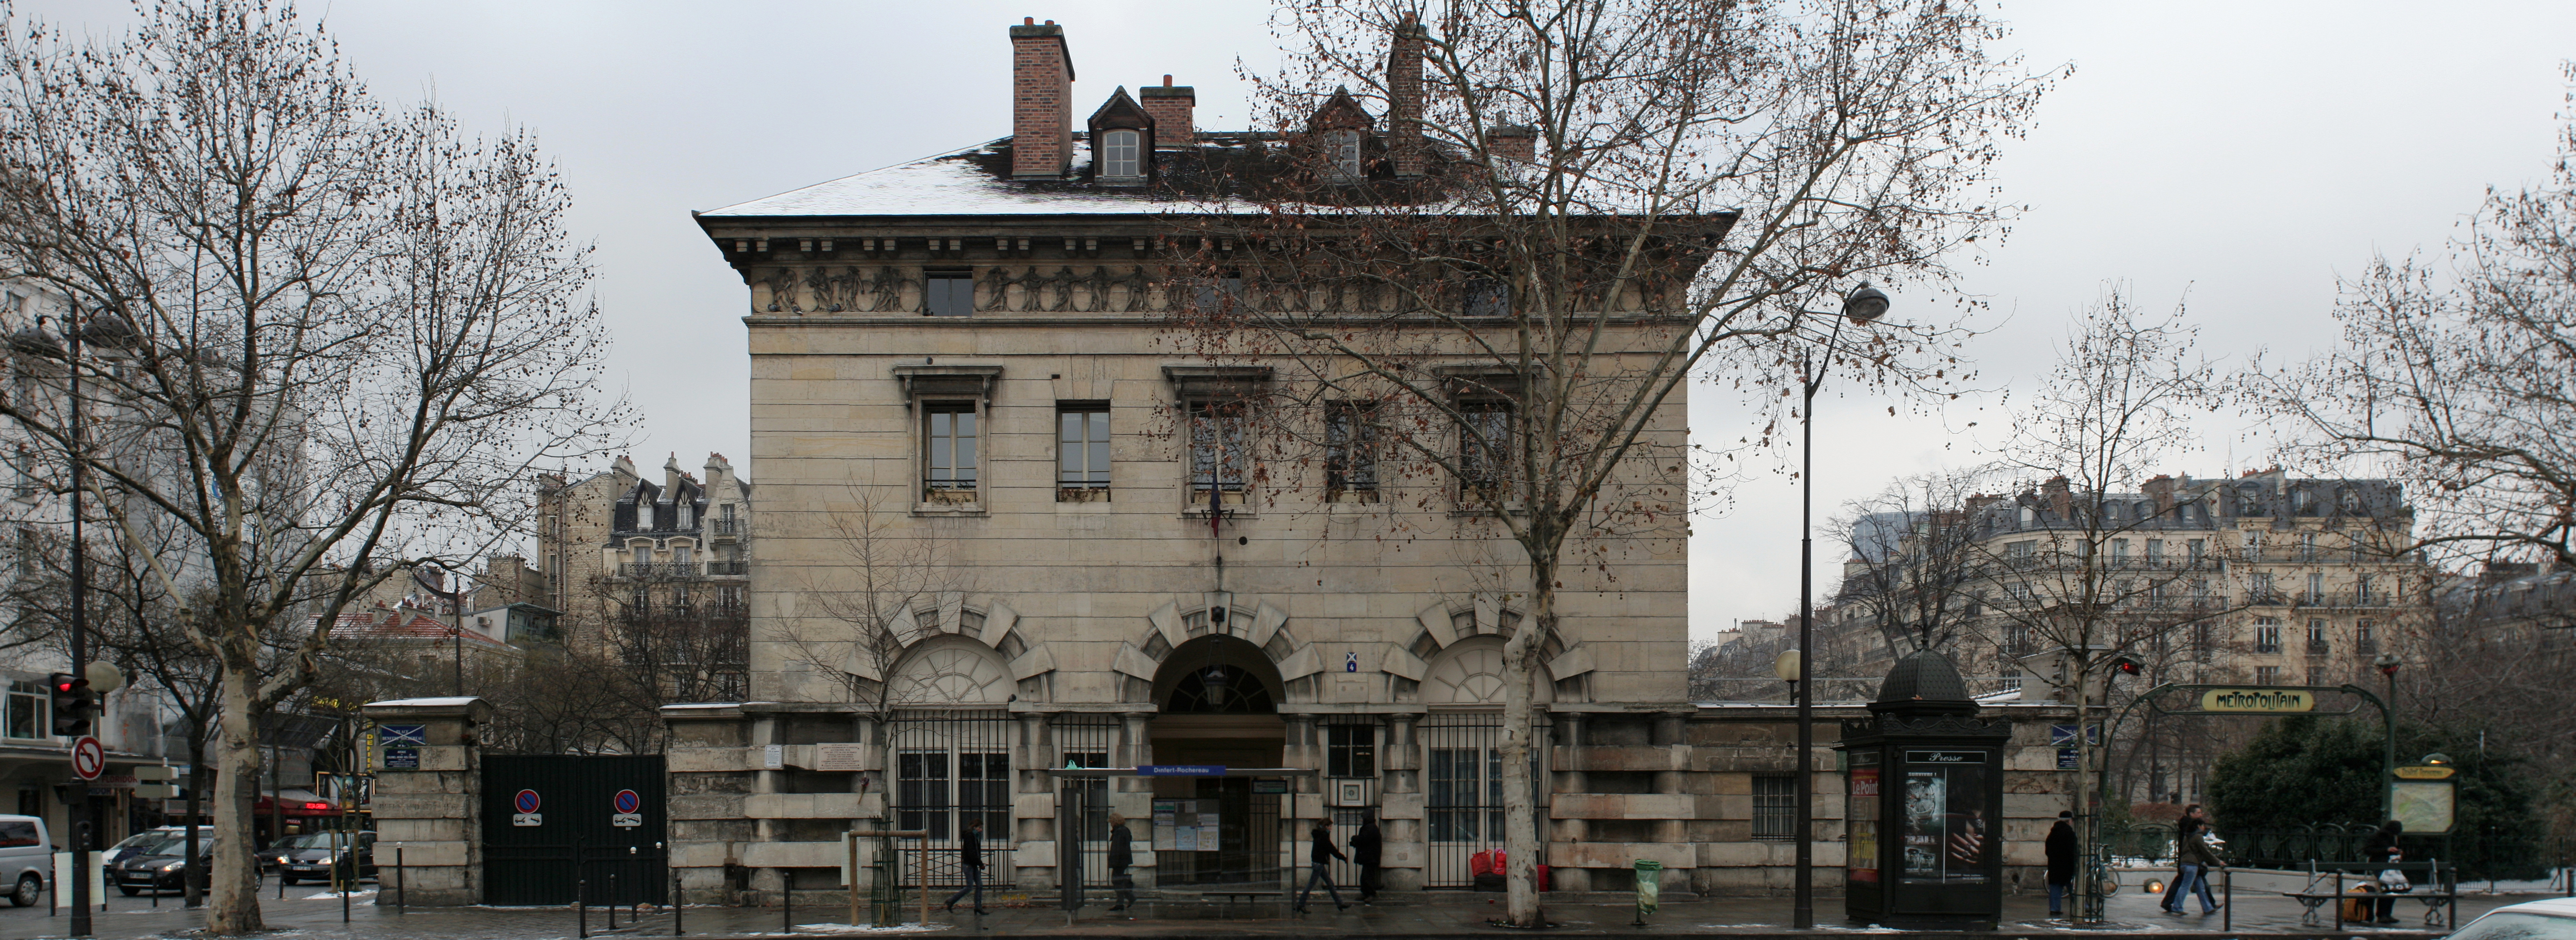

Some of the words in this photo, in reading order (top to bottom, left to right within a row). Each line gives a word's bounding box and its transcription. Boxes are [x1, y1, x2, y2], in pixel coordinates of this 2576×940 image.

[2217, 691, 2300, 710] METROPOLITAIN
[1929, 752, 1963, 761] Presse
[1852, 781, 1860, 795] Le
[1860, 779, 1878, 795] Point
